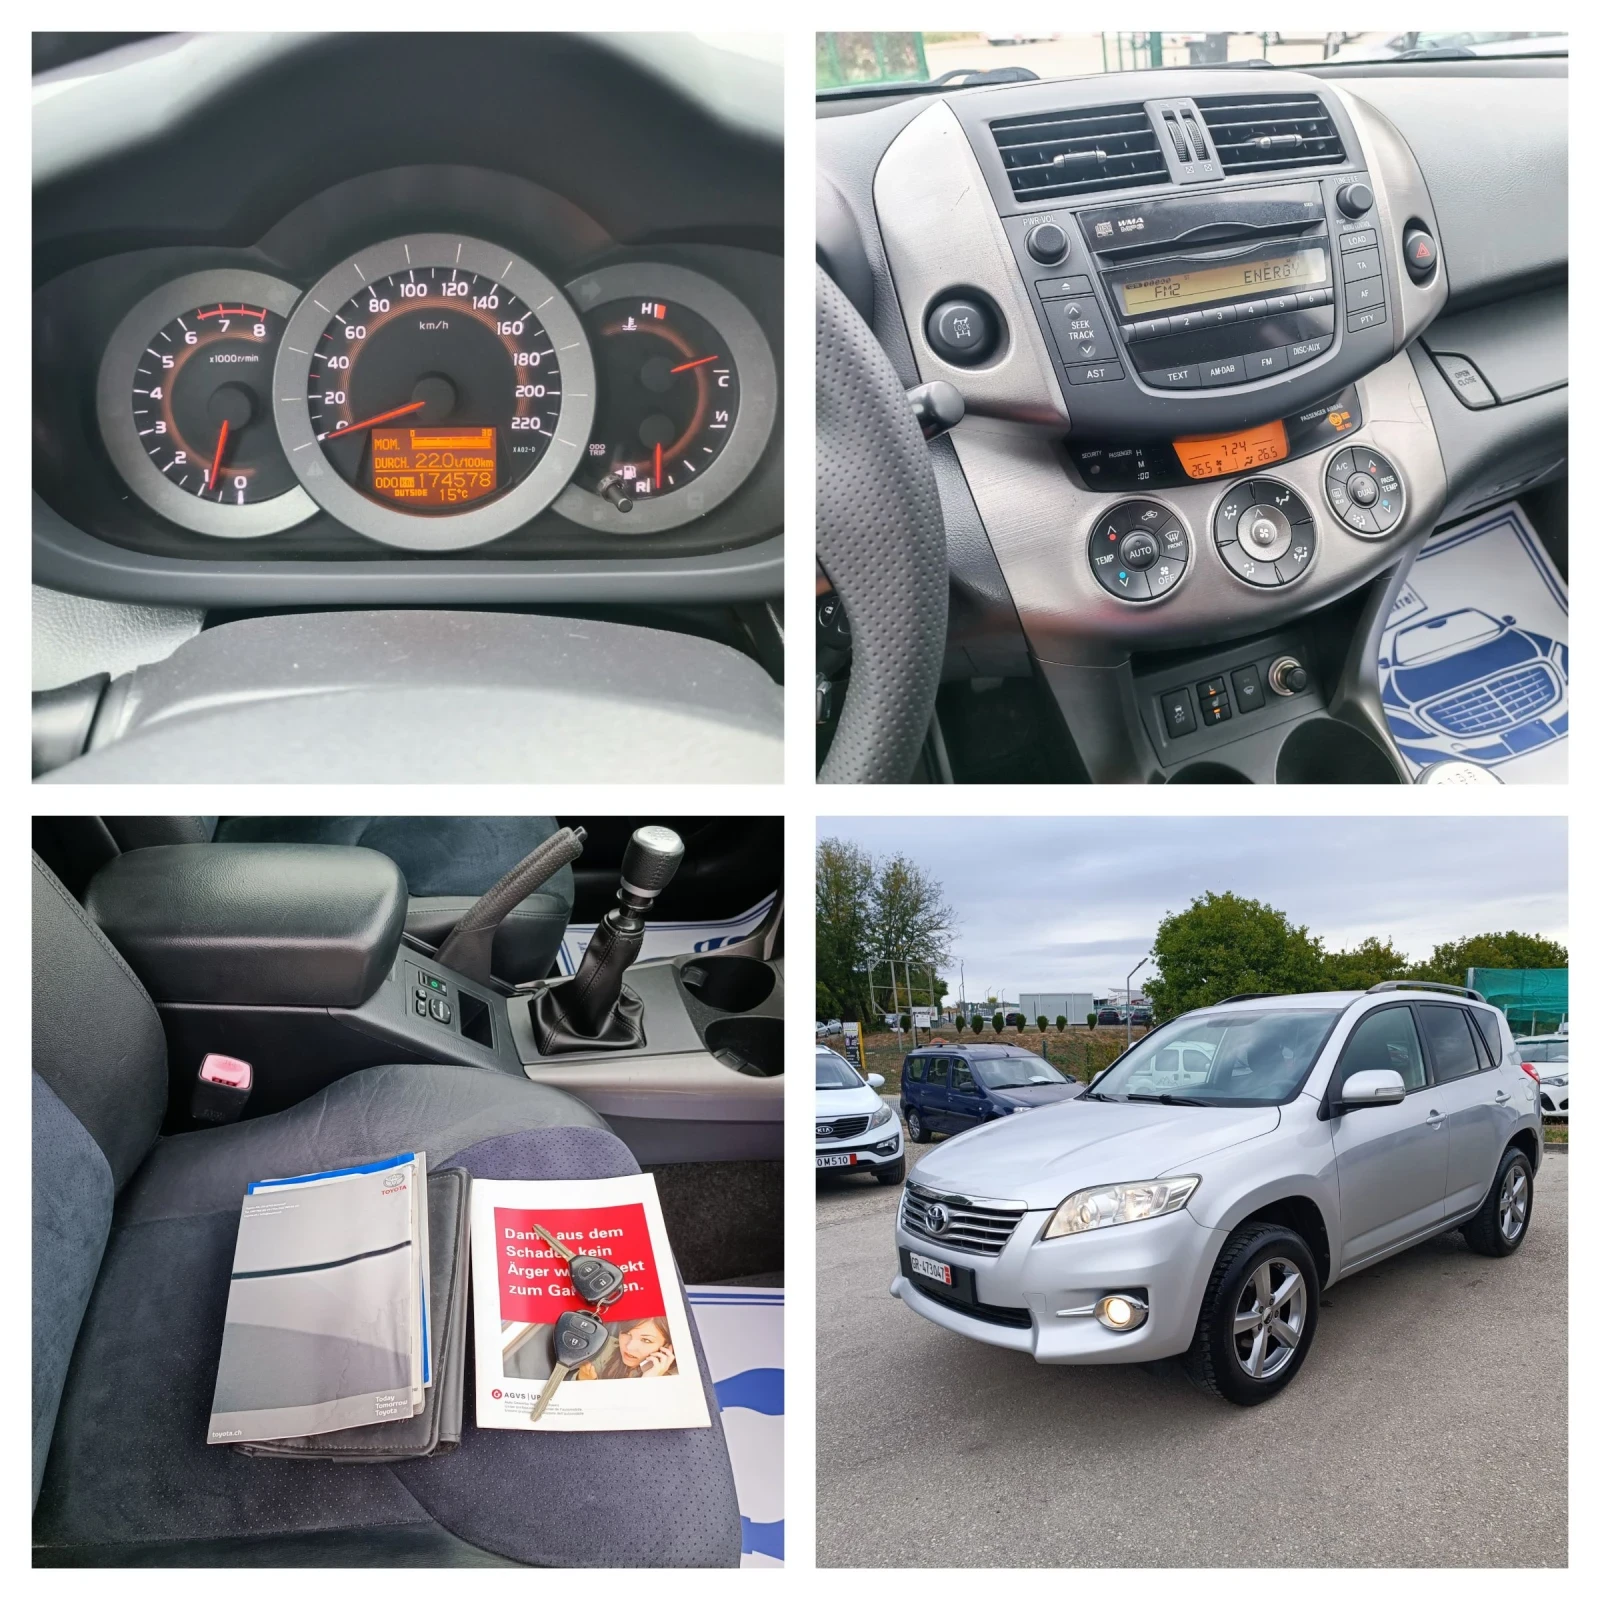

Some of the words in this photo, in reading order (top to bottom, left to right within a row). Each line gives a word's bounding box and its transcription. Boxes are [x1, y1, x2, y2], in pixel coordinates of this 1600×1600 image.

[1118, 217, 1144, 226] WMA
[1348, 235, 1366, 246] LOAD
[400, 284, 427, 297] 100
[442, 282, 468, 296] 120
[1155, 283, 1180, 298] FM2
[1361, 290, 1369, 298] AF
[369, 300, 390, 313] 80
[473, 296, 499, 309] 140
[1280, 300, 1285, 308] 5
[641, 303, 652, 315] H
[1217, 312, 1222, 320] 3
[1361, 314, 1374, 324] PTY
[218, 320, 230, 332] 7
[419, 321, 449, 330] km/h
[1071, 320, 1090, 330] SEEK
[1184, 318, 1190, 326] 2
[253, 324, 266, 337] 8
[345, 326, 367, 339] 60
[497, 321, 523, 335] 160
[185, 331, 198, 345] 6
[1069, 331, 1094, 340] TRACK
[162, 356, 175, 369] 5
[327, 356, 349, 369] 40
[514, 352, 540, 366] 180
[1261, 358, 1272, 366] FM
[1087, 369, 1105, 379] AST
[1167, 371, 1188, 381] TEXT
[718, 375, 730, 387] C
[150, 387, 163, 400] 4
[515, 385, 545, 397] 200
[324, 391, 346, 405] 20
[155, 421, 167, 434] 3
[511, 417, 540, 429] 220
[374, 439, 400, 450] MOM.
[174, 451, 187, 464] 2
[1082, 450, 1102, 458] SECURITY
[375, 457, 410, 469] DURCH.
[1138, 460, 1145, 468] M
[1336, 463, 1348, 471] A/C
[203, 469, 210, 482] 1
[375, 477, 398, 488] ODO
[420, 472, 491, 488] 174578
[1381, 476, 1394, 484] PASS
[234, 476, 247, 489] 0
[636, 482, 646, 492] R
[1382, 483, 1398, 492] TEMP
[394, 489, 428, 497] OUTSIDE
[1357, 488, 1374, 498] DUAL
[1130, 547, 1151, 559] AUTO
[1095, 554, 1114, 565] TEMP
[1158, 574, 1175, 585] OFF
[381, 1185, 407, 1195] TOYOTA
[504, 1228, 548, 1240] Dam
[556, 1231, 584, 1240] aus
[588, 1228, 623, 1240] dem
[578, 1246, 612, 1257] kein
[508, 1261, 549, 1279] Ärger
[509, 1285, 542, 1297] zum
[375, 1395, 395, 1403] Today
[504, 1392, 526, 1400] AGVS
[375, 1400, 408, 1409] Tomorrow
[375, 1408, 398, 1417] Toyota
[212, 1429, 242, 1438] toyota.ch
